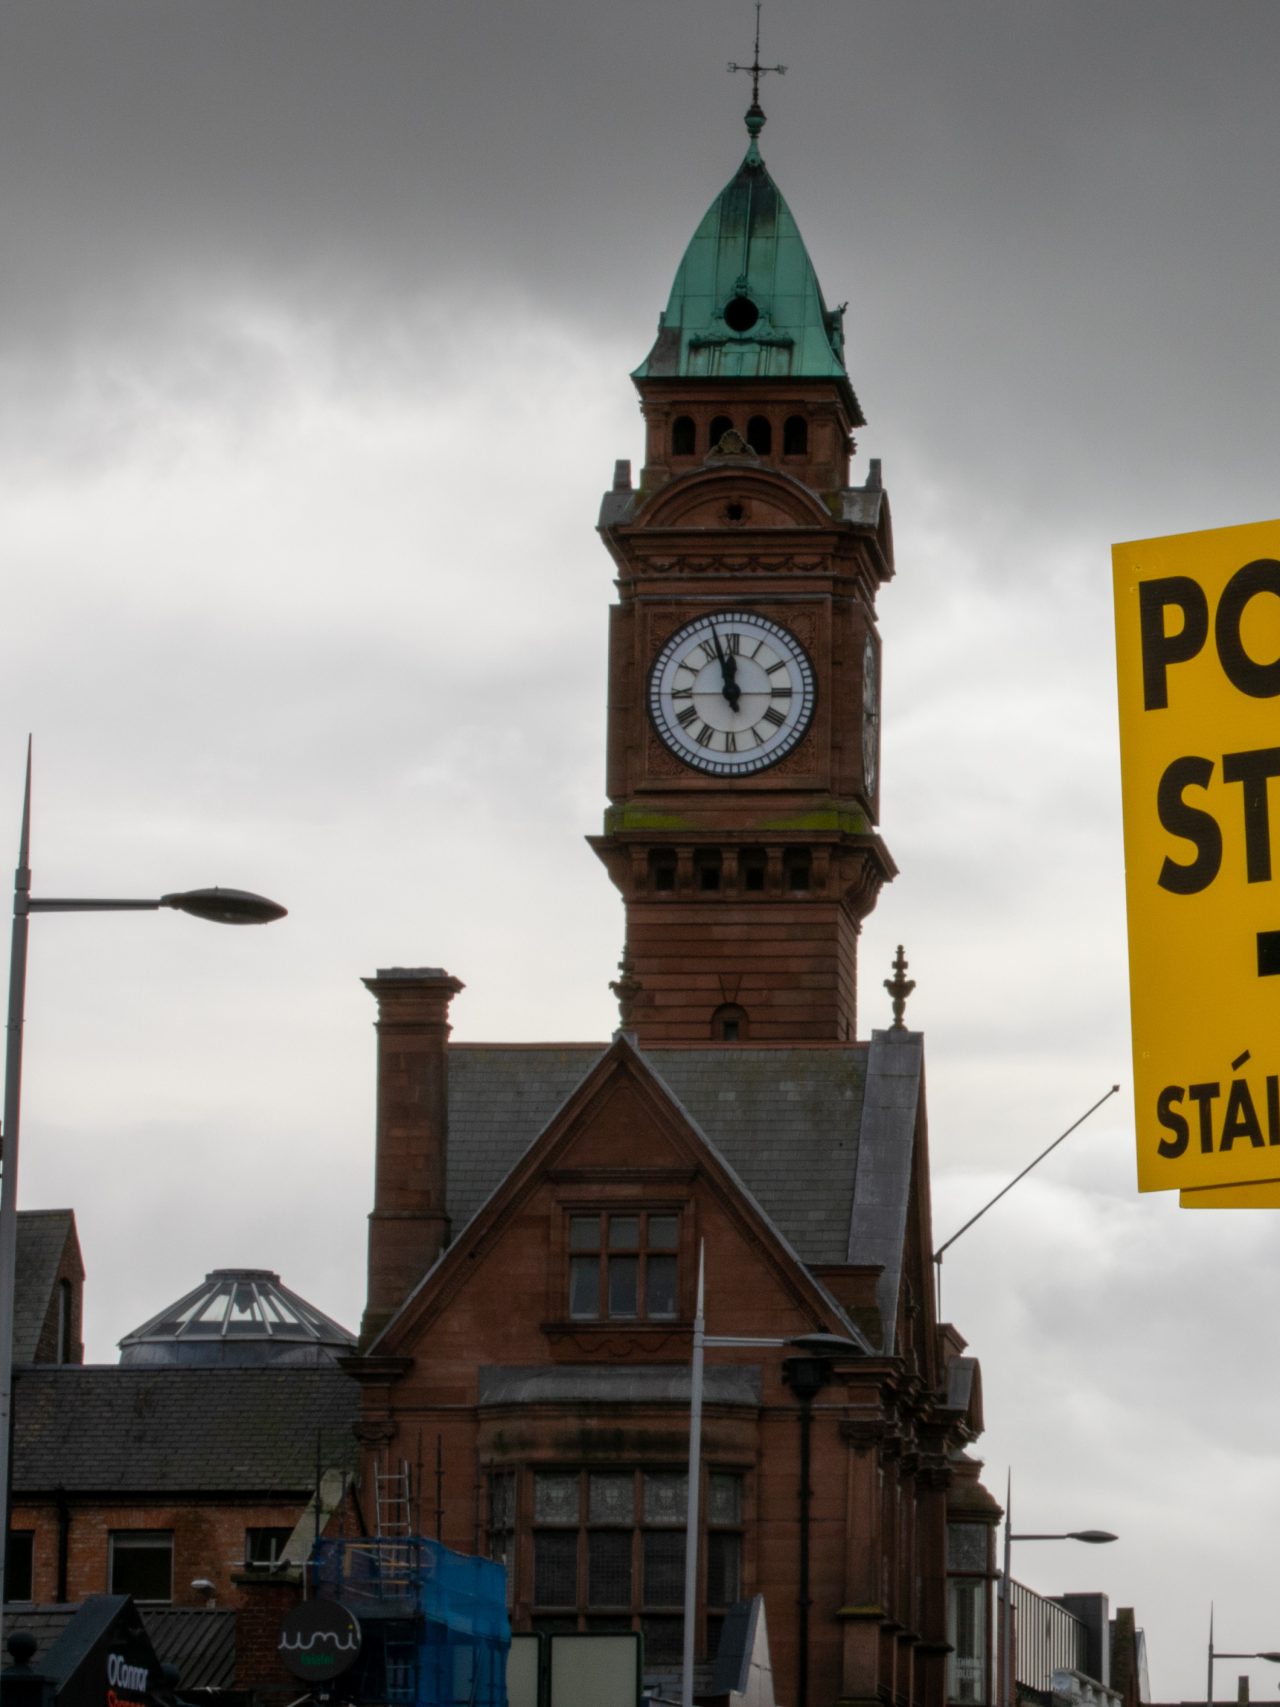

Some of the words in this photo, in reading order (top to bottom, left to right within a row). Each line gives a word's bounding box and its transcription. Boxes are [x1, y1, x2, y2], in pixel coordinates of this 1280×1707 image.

[724, 633, 740, 655] XII
[771, 688, 792, 697] III
[278, 1623, 357, 1650] umi
